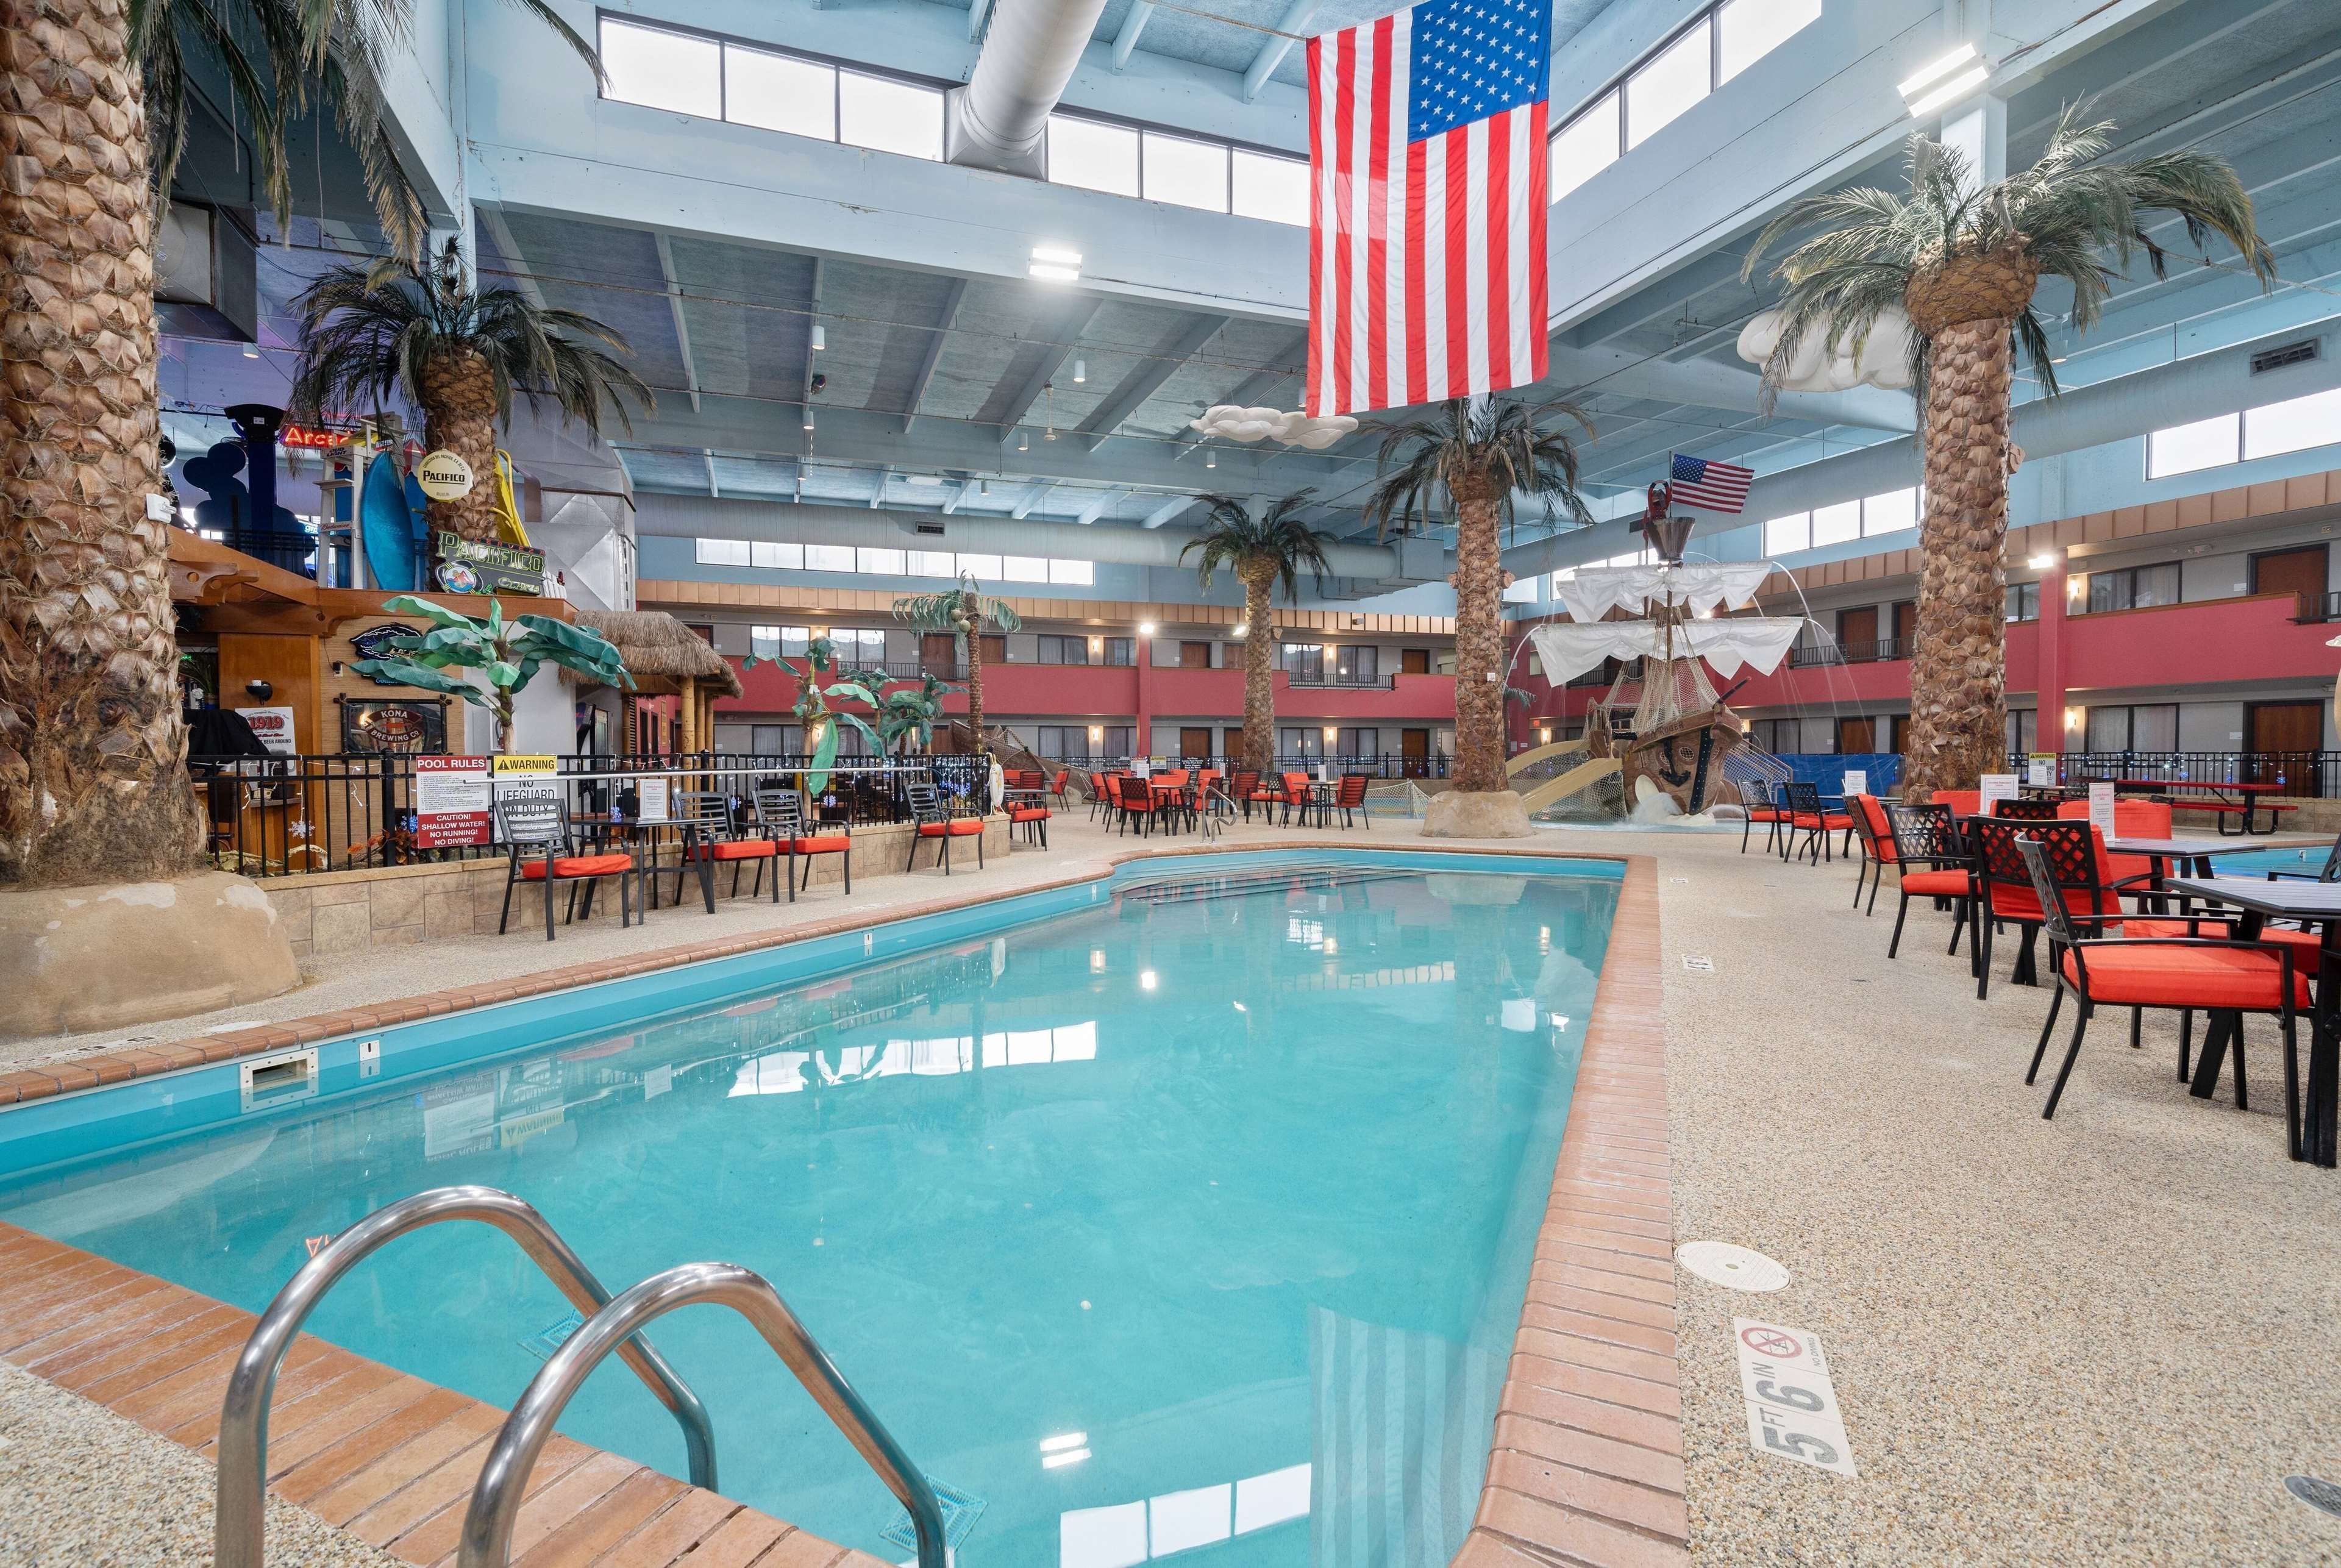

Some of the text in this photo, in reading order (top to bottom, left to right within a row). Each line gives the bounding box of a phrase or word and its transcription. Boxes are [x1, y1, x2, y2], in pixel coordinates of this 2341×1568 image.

[423, 470, 465, 482] PACIFICO
[435, 531, 545, 573] PACIFICO
[474, 536, 546, 556] CERVEZA
[248, 715, 285, 730] 1919
[371, 730, 409, 742] BREWING
[417, 759, 485, 768] POOL RULES
[510, 760, 555, 769] WARNING
[519, 775, 534, 788] NO
[497, 789, 555, 800] LIFEGUARD
[522, 805, 549, 817] DUTY
[1807, 1336, 1822, 1367] NO DIVING
[1751, 1361, 1839, 1464] 5 FT 6 IN
